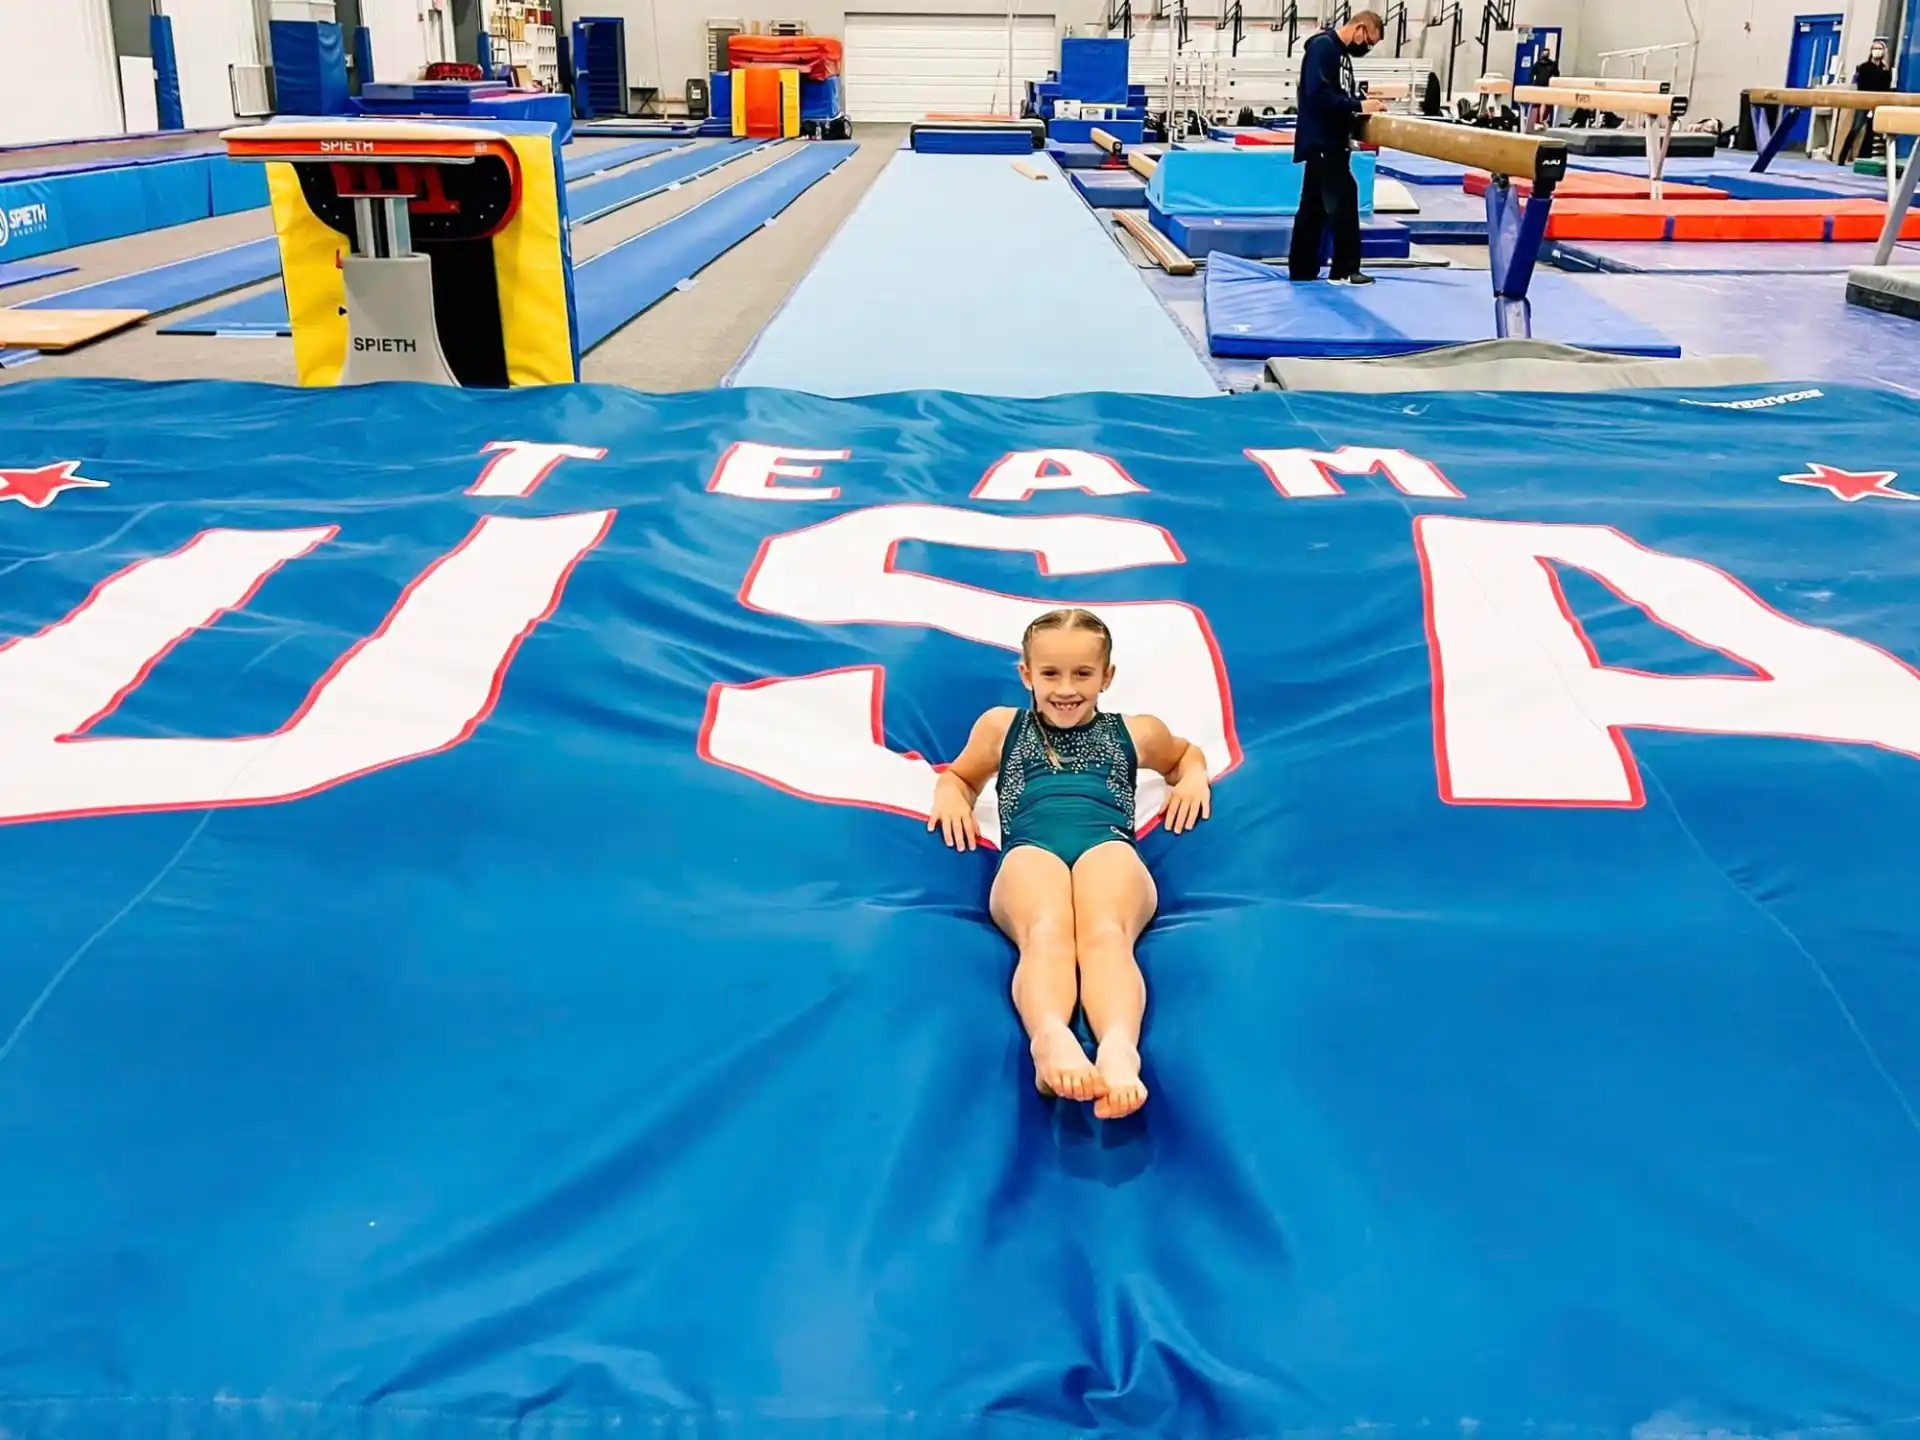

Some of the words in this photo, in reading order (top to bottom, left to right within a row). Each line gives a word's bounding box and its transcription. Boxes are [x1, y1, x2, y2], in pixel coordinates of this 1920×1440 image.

[320, 140, 374, 153] SPIETH
[8, 203, 47, 229] SPIETH
[354, 336, 417, 353] SPIETH
[464, 440, 1467, 500] TEAM
[0, 503, 1920, 849] USA
